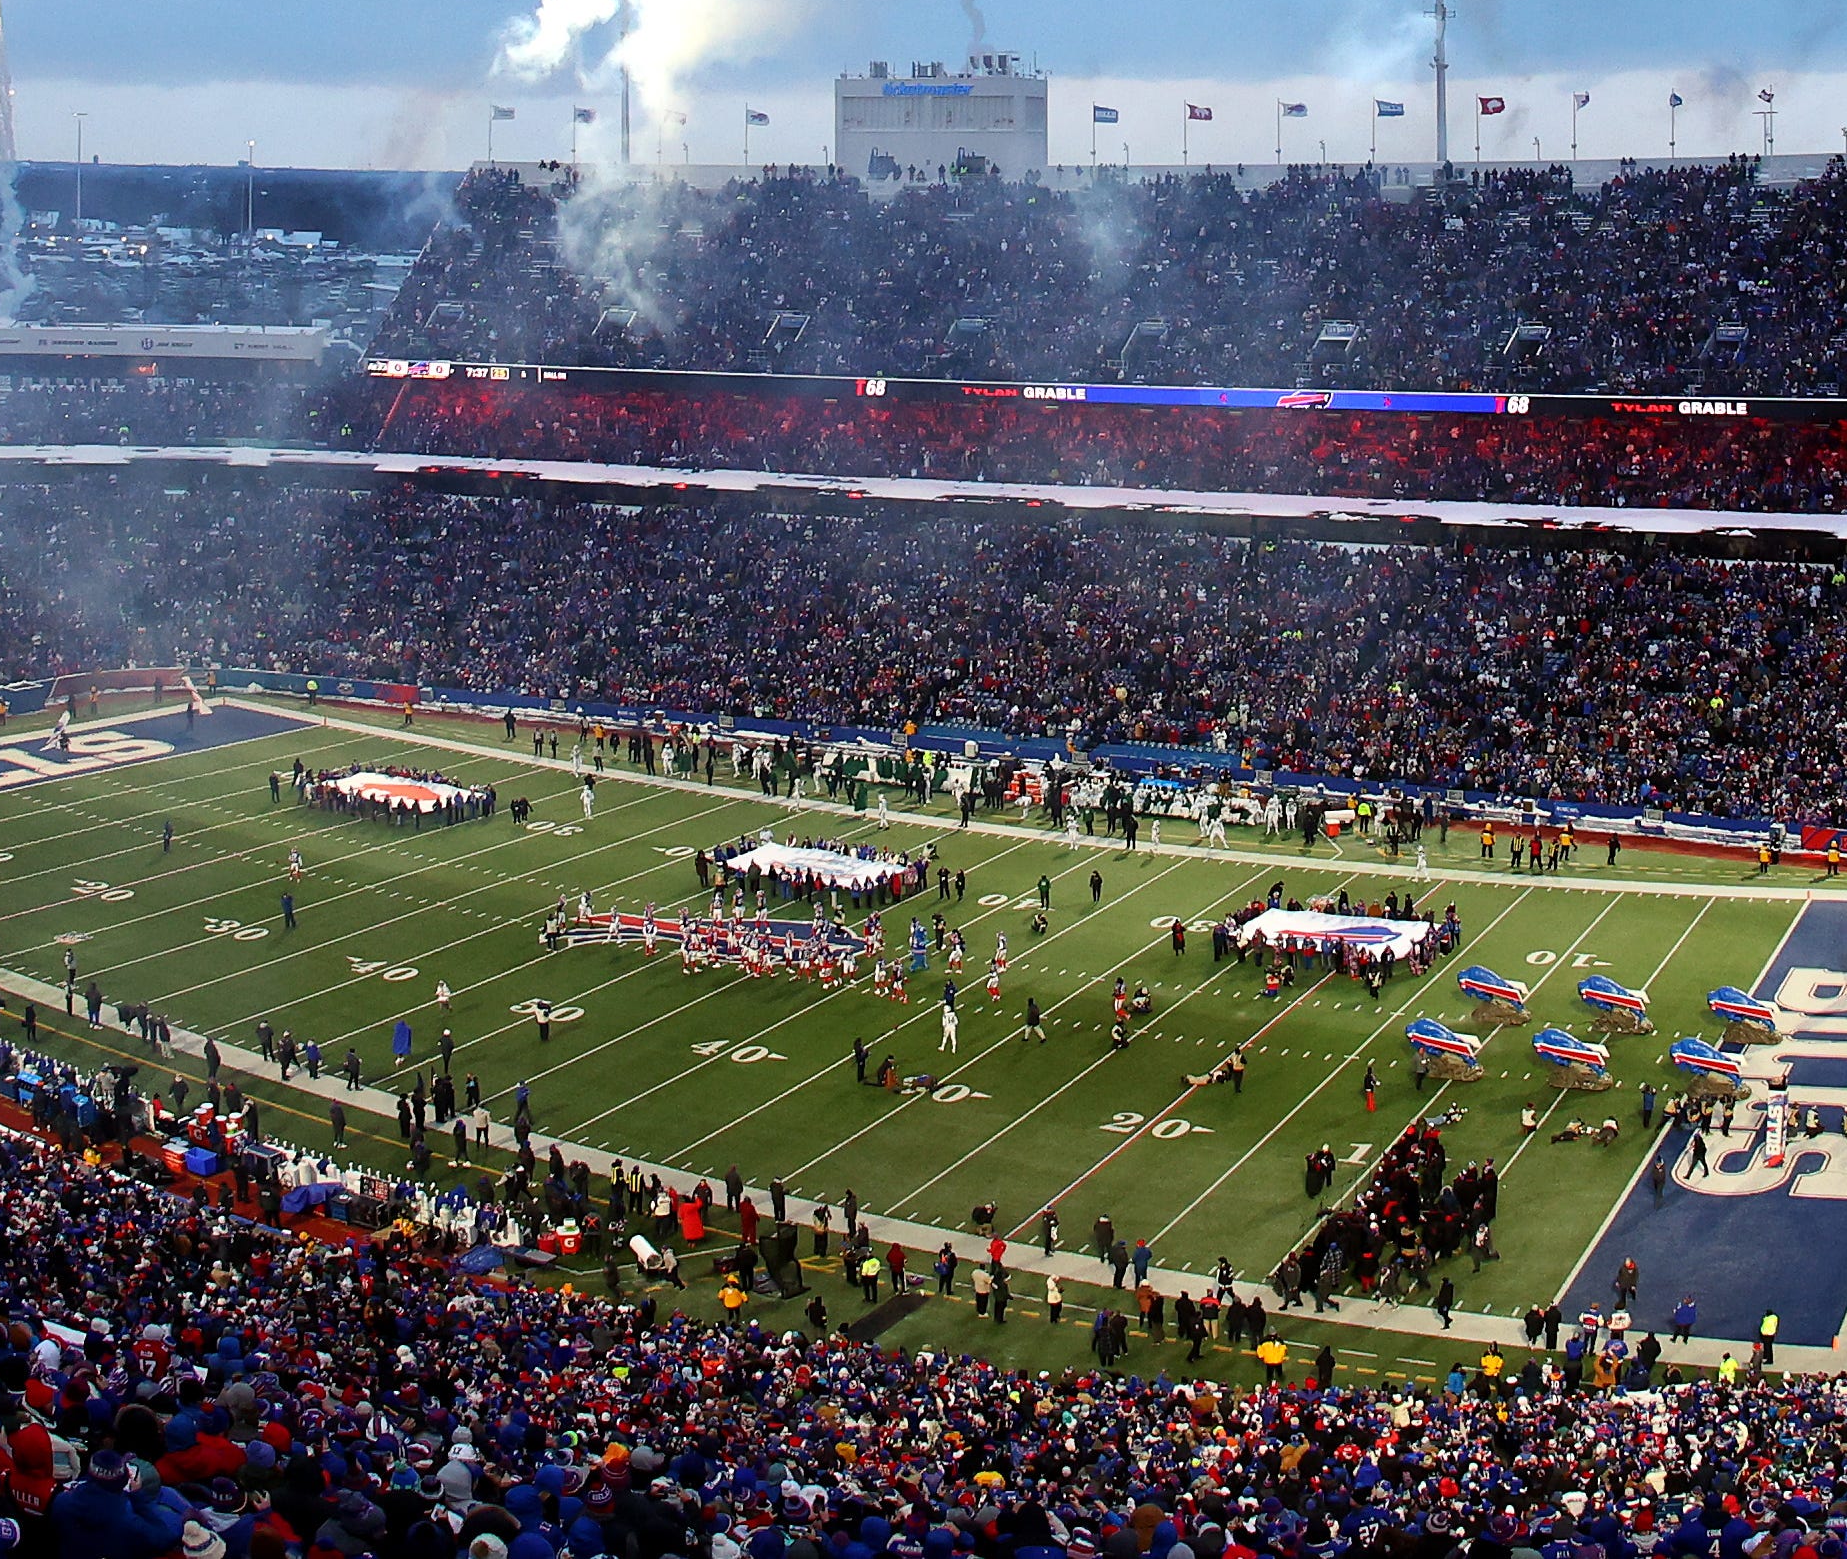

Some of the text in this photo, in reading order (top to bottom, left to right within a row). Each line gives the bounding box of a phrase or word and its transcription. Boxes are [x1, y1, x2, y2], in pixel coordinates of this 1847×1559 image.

[466, 368, 488, 378] 7:37
[1023, 387, 1086, 400] GRABLE
[1611, 401, 1747, 415] TYLAN GRABLE
[77, 878, 135, 902] 20
[208, 917, 270, 942] 30
[351, 955, 420, 982] 40
[691, 1040, 770, 1064] 40
[1100, 1113, 1192, 1140] 20
[1766, 1104, 1783, 1156] BILLS
